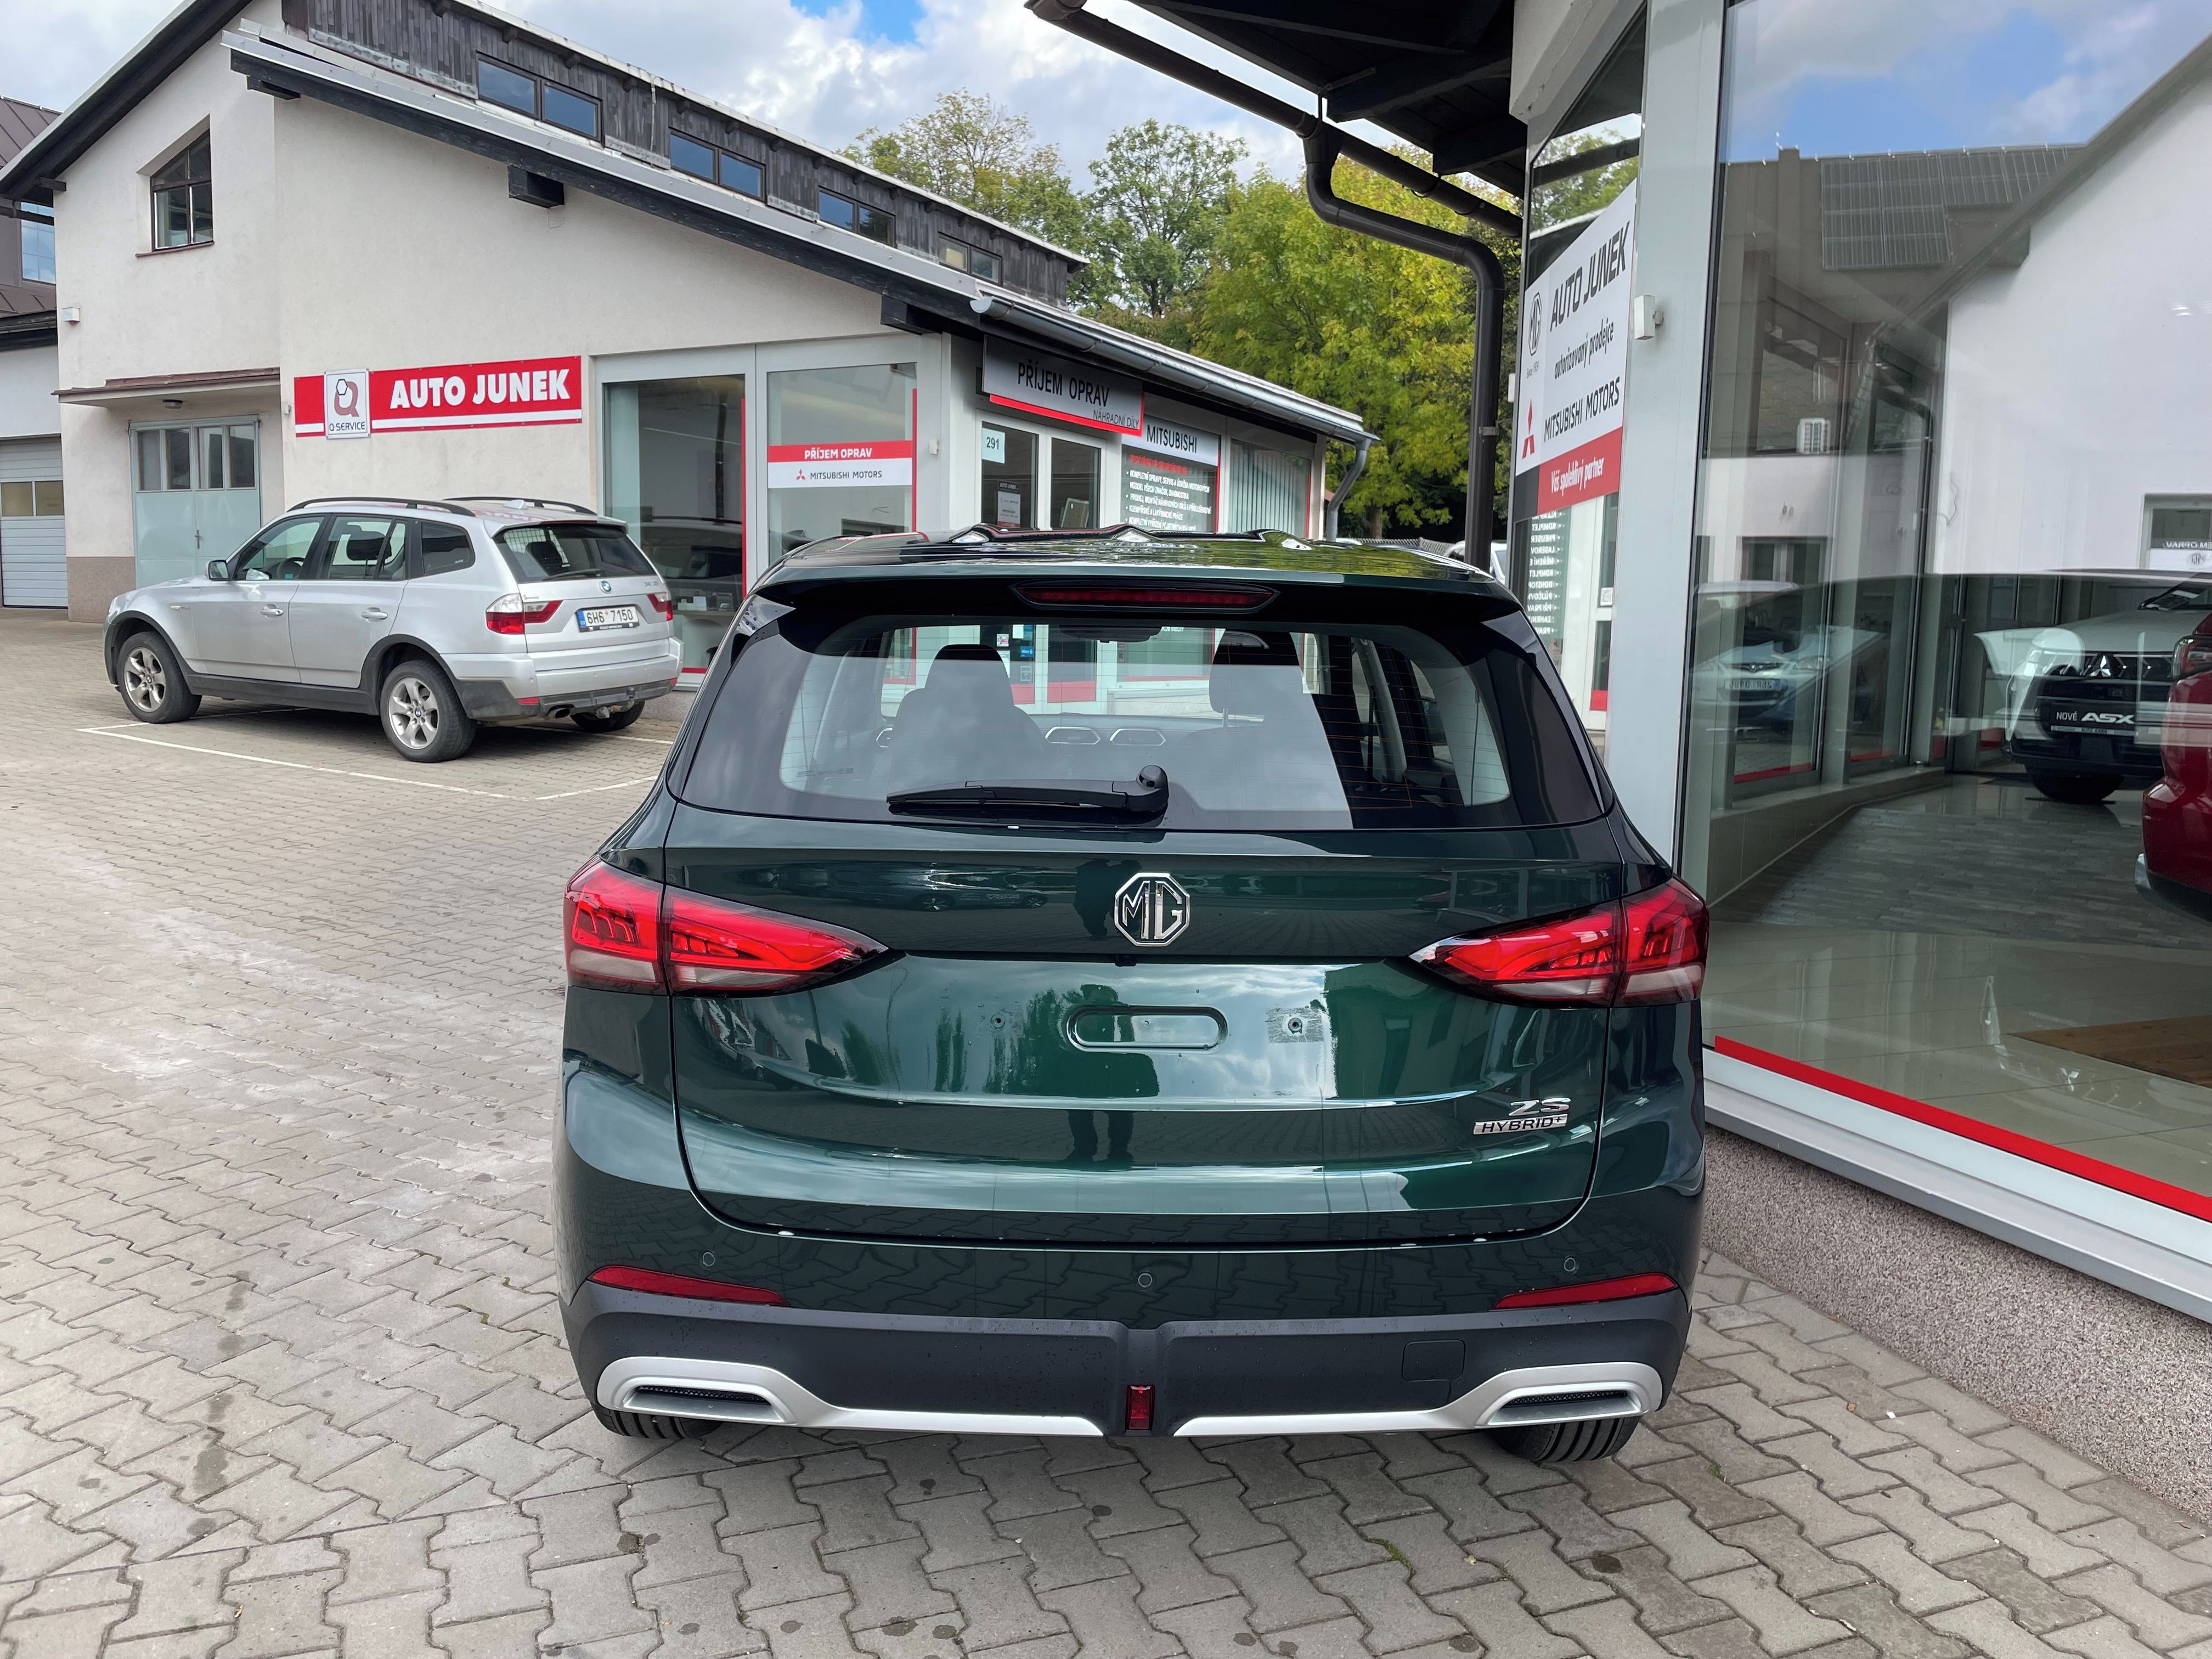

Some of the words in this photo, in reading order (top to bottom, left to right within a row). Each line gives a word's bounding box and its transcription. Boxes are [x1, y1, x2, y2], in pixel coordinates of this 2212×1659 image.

[1550, 267, 1583, 332] AUTO
[1583, 221, 1630, 304] JUNEK
[1529, 298, 1541, 350] MG
[1554, 332, 1588, 380] autorizovaný
[1588, 317, 1614, 365] prodejce
[390, 376, 466, 409] AUTO
[472, 368, 571, 405] JUNEK
[1018, 358, 1063, 396] PŘÍJEM
[1069, 377, 1110, 407] OPRAV
[1093, 408, 1126, 426] NÁHRADNÍ
[1126, 415, 1139, 428] DÍLY
[1544, 398, 1583, 443] MITSUBISHI
[1585, 376, 1620, 421] MOTORS
[804, 447, 839, 460] PŘÍJEM
[840, 448, 872, 459] OPRAV
[986, 436, 999, 450] 291
[1147, 425, 1197, 454] MITSUBISHI
[810, 471, 849, 480] MITSUBISHI
[853, 470, 882, 479] MOTORS
[1583, 456, 1605, 489] partner
[586, 611, 605, 624] 6H6
[611, 609, 634, 622] 7150
[2057, 711, 2077, 721] NOVÉ
[2081, 712, 2135, 725] ASX
[1122, 880, 1183, 939] MG
[1508, 1097, 1571, 1116] ZS
